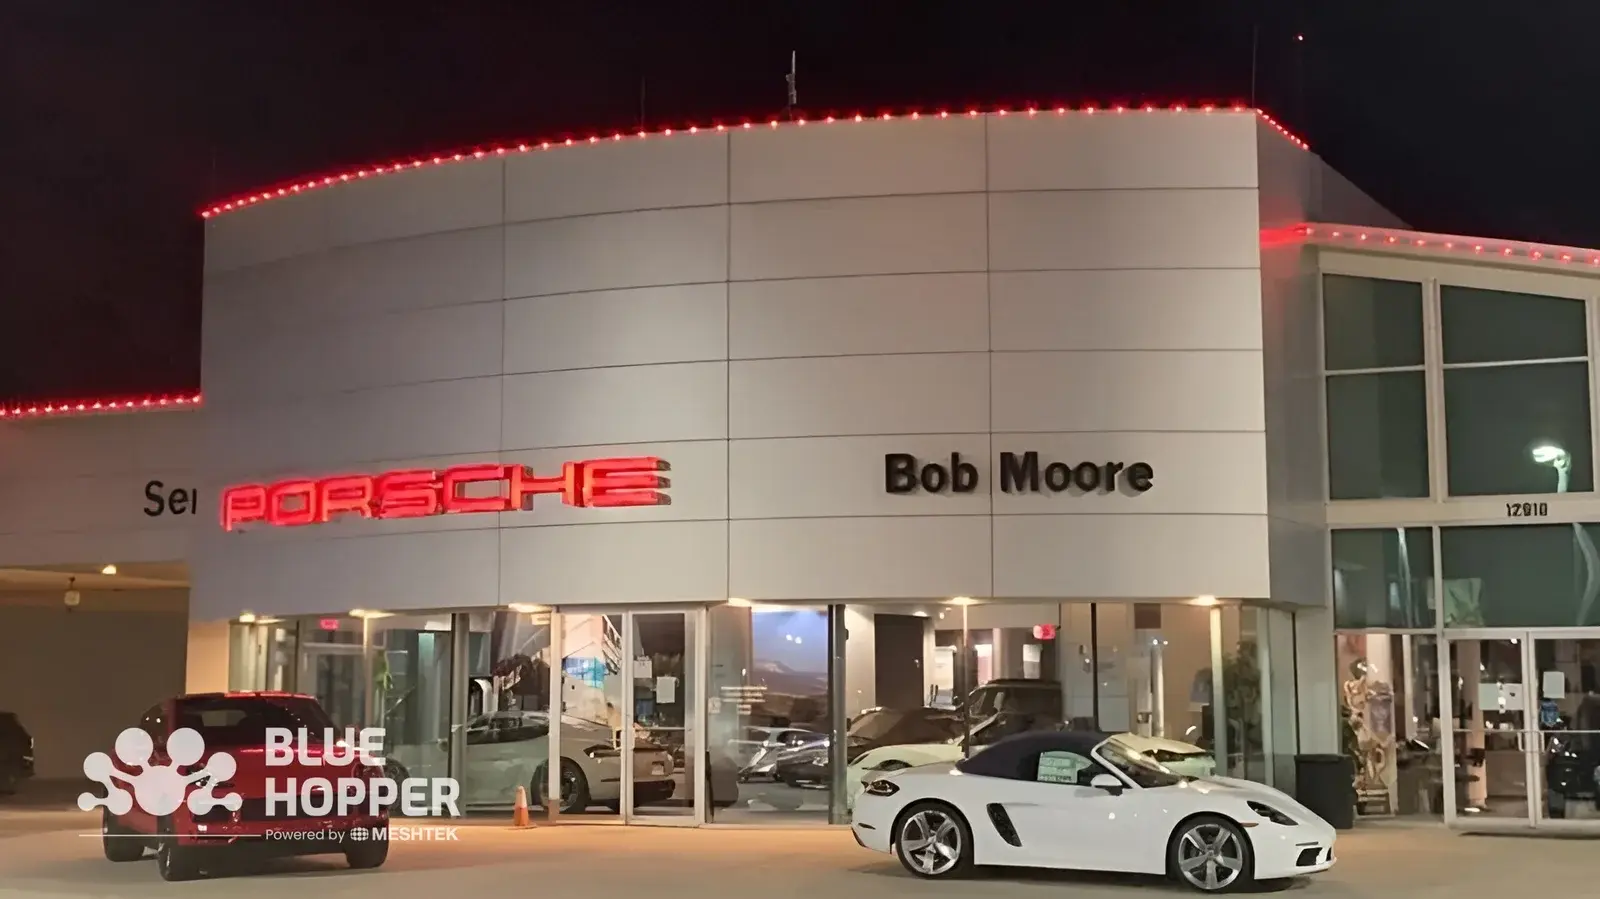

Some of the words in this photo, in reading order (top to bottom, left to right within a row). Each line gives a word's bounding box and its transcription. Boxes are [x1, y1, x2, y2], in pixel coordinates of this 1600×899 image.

[221, 456, 672, 531] PORSCHE
[885, 452, 978, 493] Bob
[1000, 451, 1153, 492] Moore
